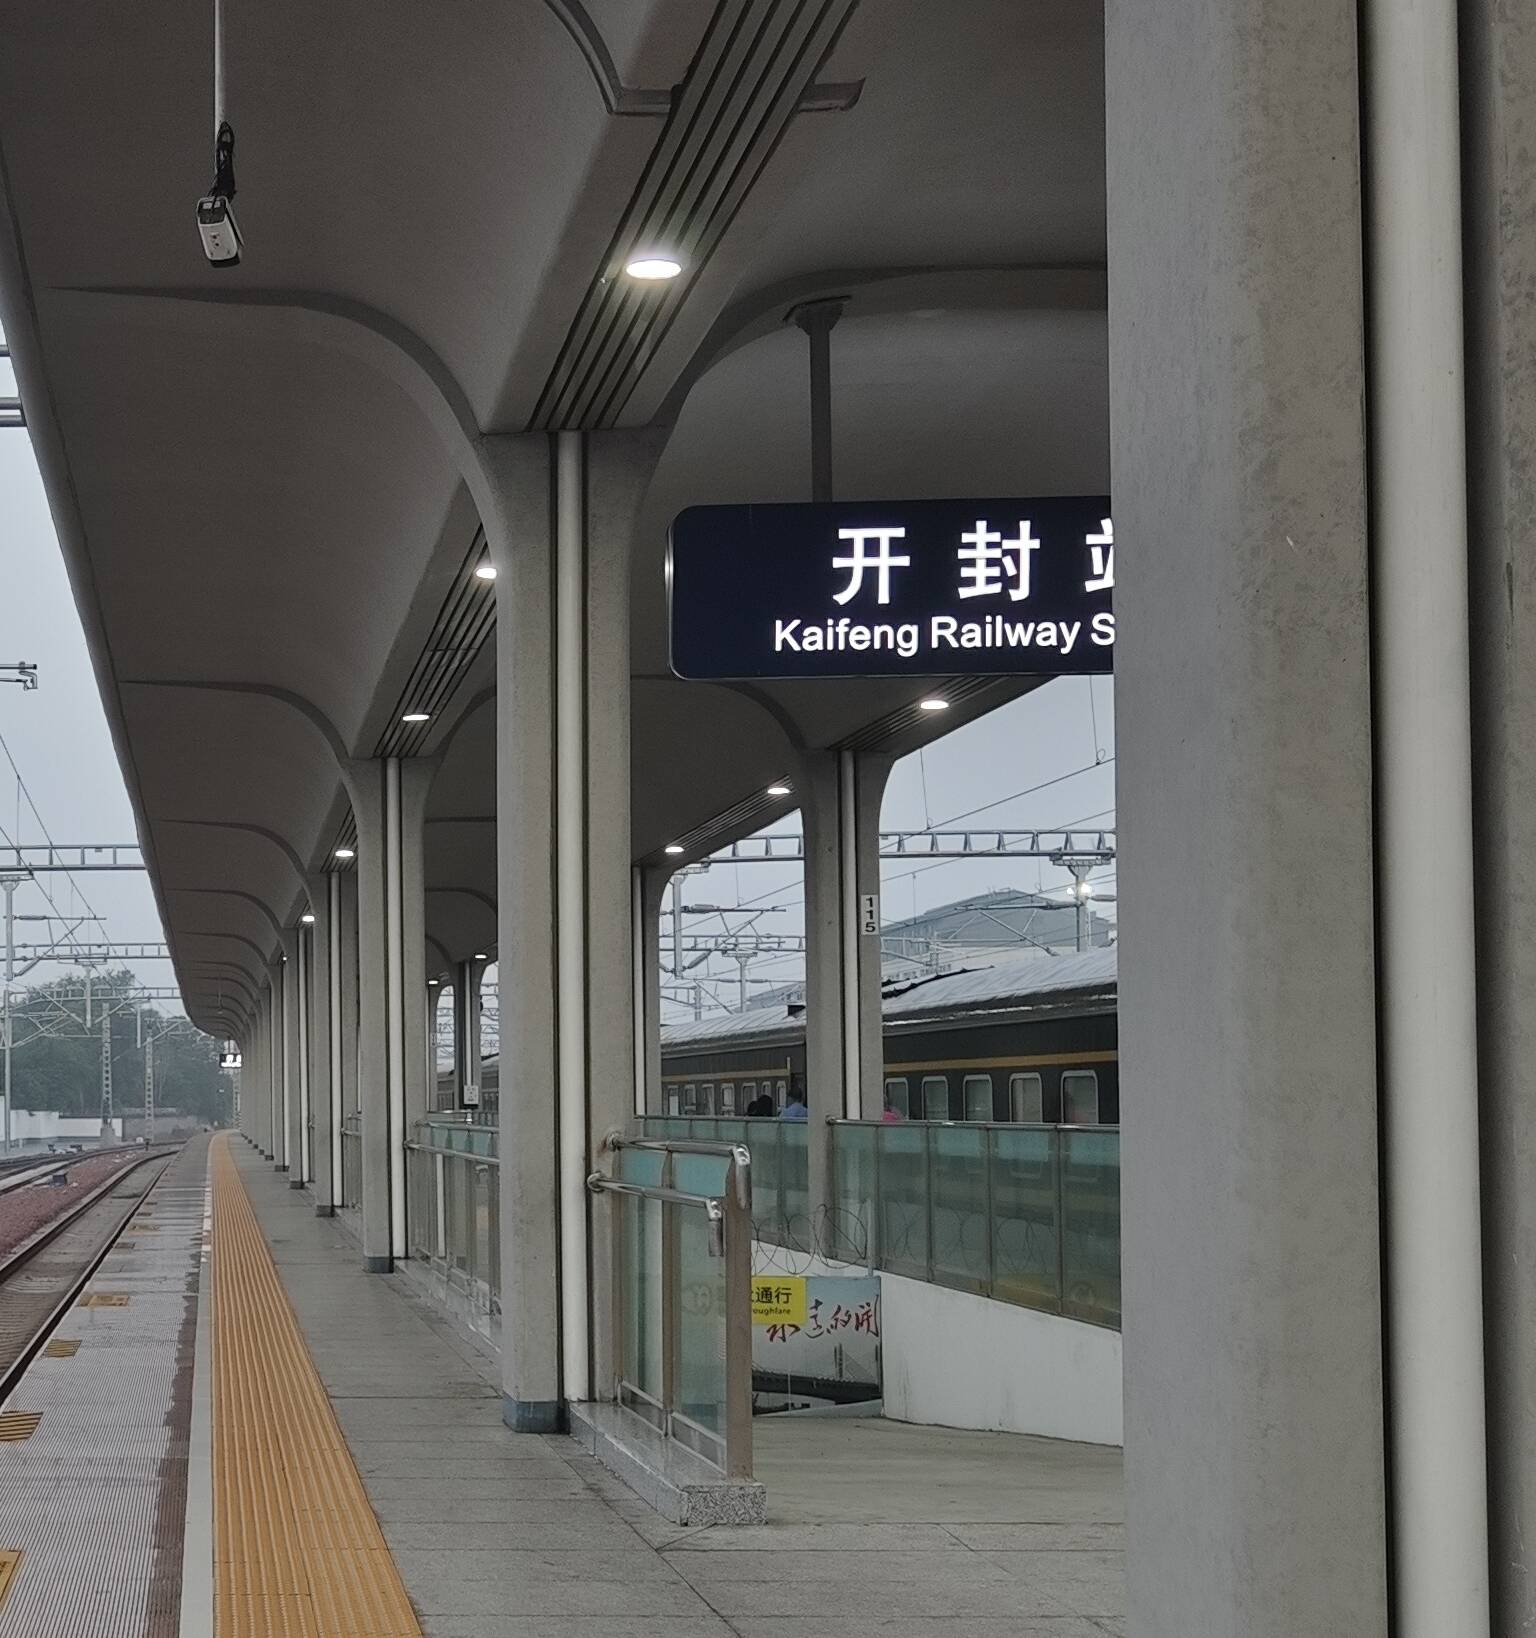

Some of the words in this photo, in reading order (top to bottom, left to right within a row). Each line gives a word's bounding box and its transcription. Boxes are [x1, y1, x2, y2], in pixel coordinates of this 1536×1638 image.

[775, 618, 919, 657] Kaifeng
[931, 616, 1082, 655] Railway
[865, 896, 877, 933] 115
[751, 1286, 792, 1304] 通行
